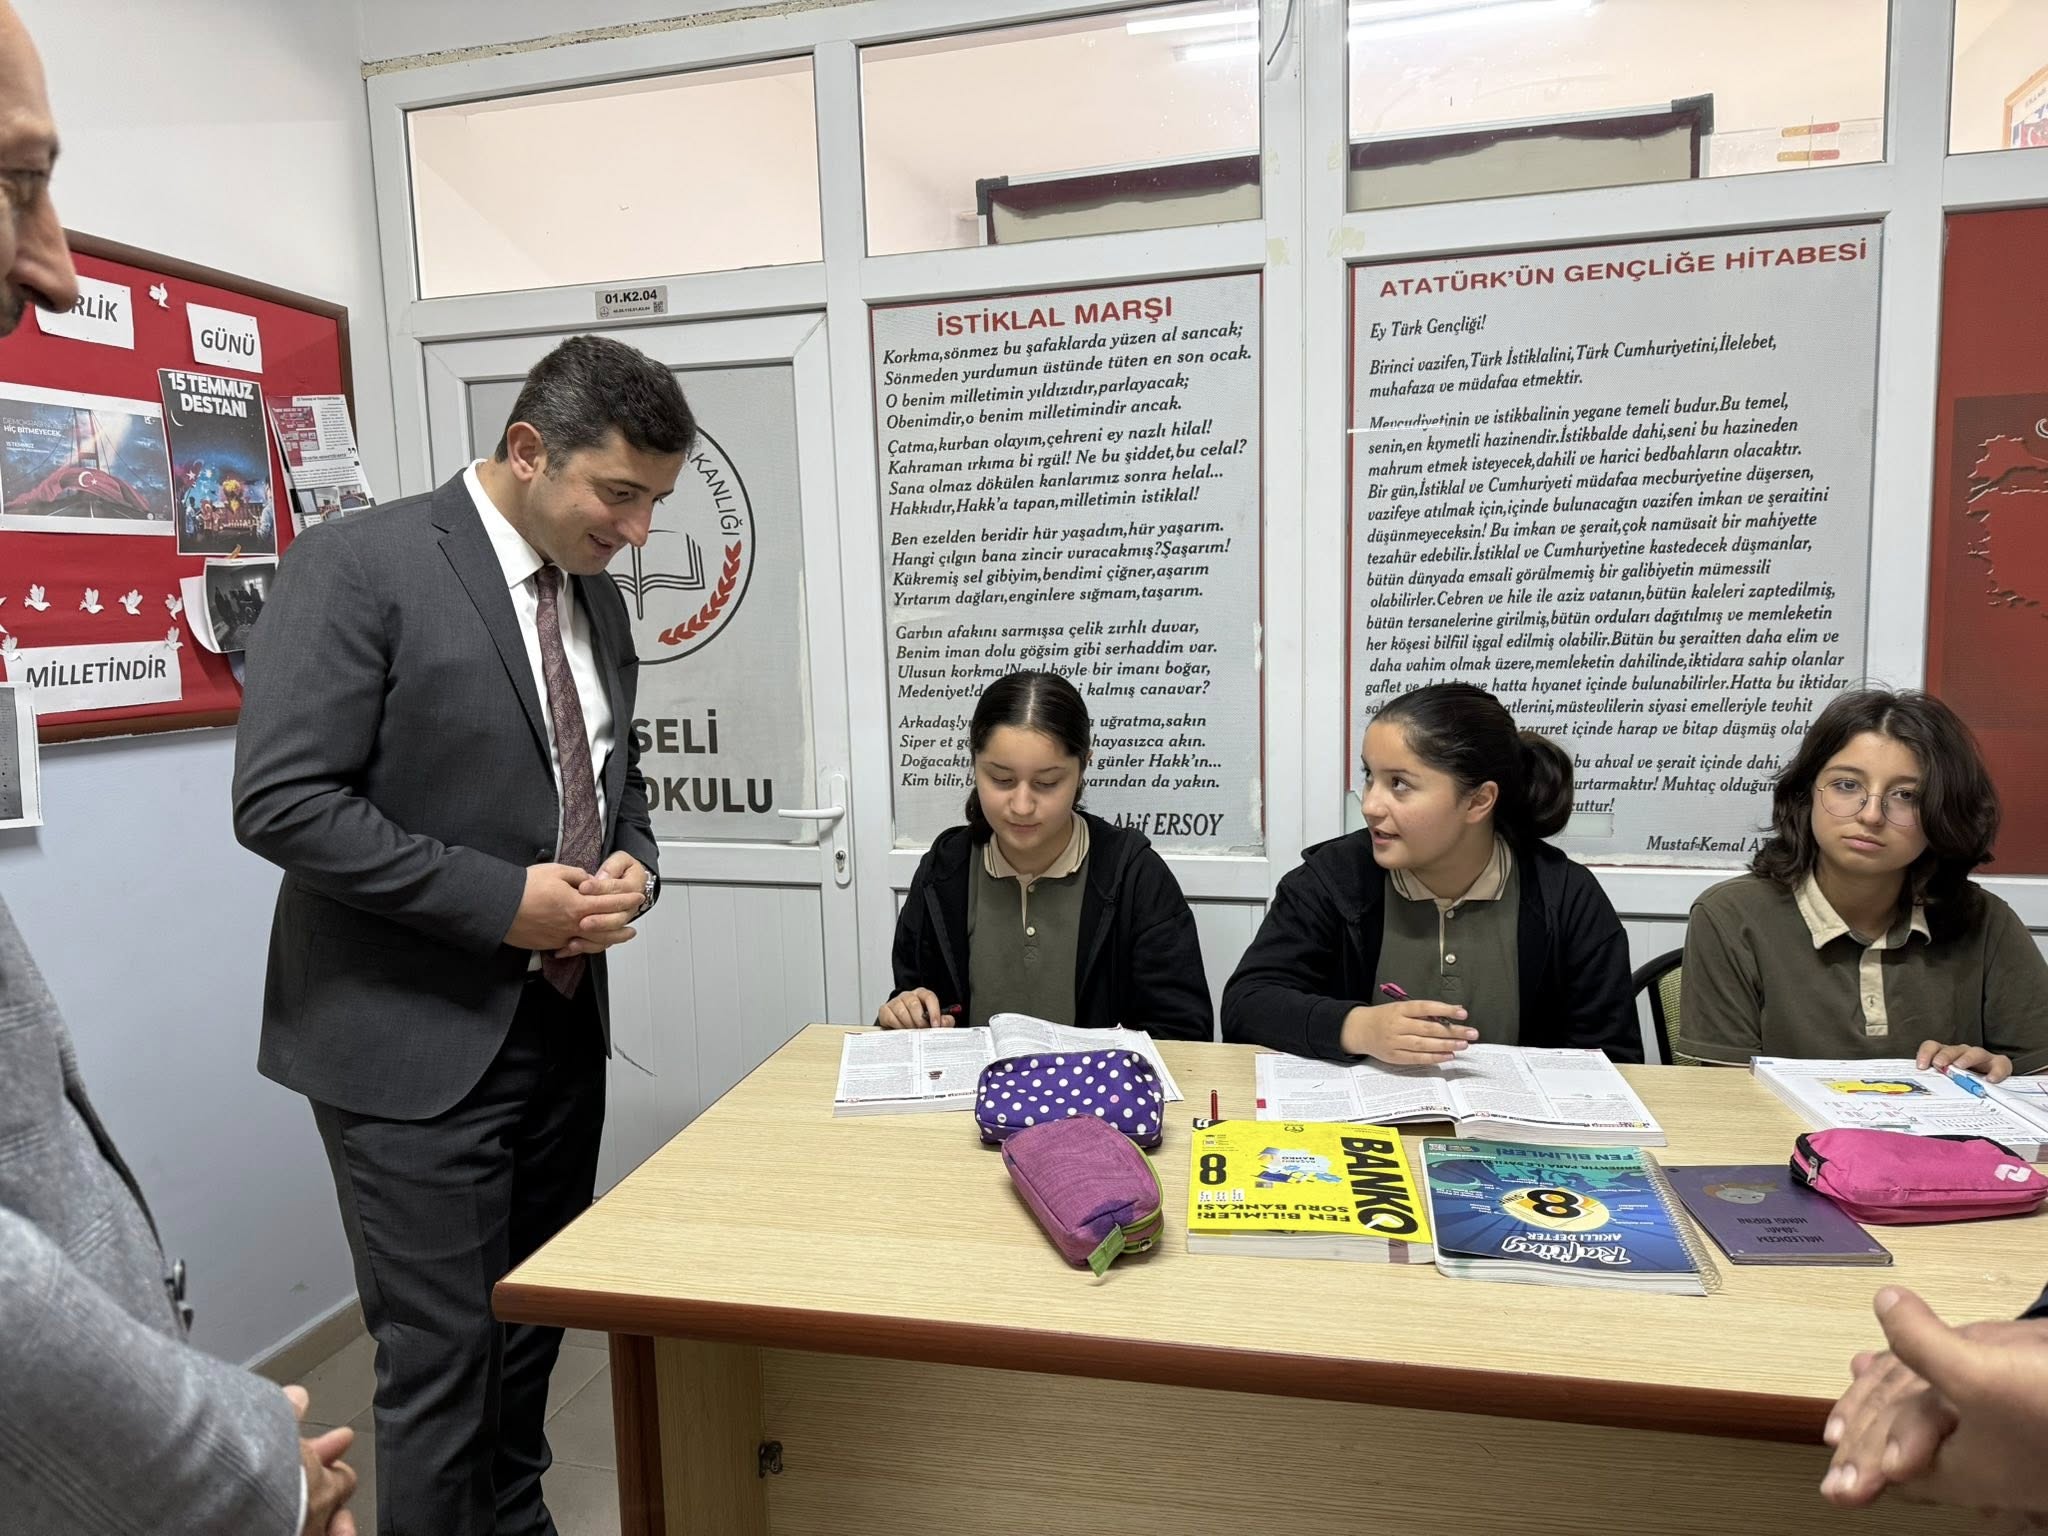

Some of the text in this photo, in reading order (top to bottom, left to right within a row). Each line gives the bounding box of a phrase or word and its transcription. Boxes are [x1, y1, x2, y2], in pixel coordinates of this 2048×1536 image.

[1379, 237, 1867, 298] ATATÜRK'ÜN GENÇLİĞE HİTABESİ
[71, 294, 118, 323] RLİK
[605, 289, 657, 304] 01.K2.04
[937, 296, 1172, 336] İSTİKLAL MARŞI
[1370, 314, 1486, 341] Ey Türk Gençliği!
[201, 327, 255, 356] GÜNÜ
[1003, 340, 1021, 355] bu
[1026, 332, 1106, 357] şafaklarda
[1109, 332, 1156, 350] yüzen
[1161, 325, 1178, 342] al
[1181, 320, 1243, 340] sancak;
[884, 344, 1251, 386] Sönmeden yurdumun üstünde tüten en son ocak.
[1369, 357, 1414, 375] Birinci
[168, 372, 254, 400] 15 TEMMUZ
[1369, 369, 1582, 398] muhafaza ve müdafaa etmektir.
[180, 392, 248, 418] DESTANI
[1106, 430, 1123, 443] ey
[1128, 422, 1166, 439] nazlı
[1171, 418, 1212, 436] hilal!
[1368, 460, 1422, 476] mahrum
[1427, 455, 1468, 473] etmek
[1579, 454, 1595, 465] ve
[1599, 447, 1640, 464] harici
[1644, 443, 1728, 462] bedbahların
[1733, 440, 1801, 458] olacaktır.
[691, 452, 743, 536] KANLIĞI
[888, 480, 924, 495] Sana
[929, 478, 972, 493] olmaz
[976, 474, 1034, 491] dökülen
[1039, 471, 1119, 488] kanlarımız
[1124, 471, 1166, 483] sonra
[1368, 504, 1420, 522] vazifeye
[1424, 500, 1475, 518] atılmak
[1552, 496, 1637, 513] bulunacağın
[1642, 491, 1693, 508] vazifen
[1698, 489, 1742, 506] imkan
[1747, 493, 1764, 504] ve
[1767, 486, 1830, 507] şeraitini
[890, 531, 918, 546] Ben
[922, 529, 976, 544] ezelden
[980, 526, 1028, 542] beridir
[1032, 525, 1058, 540] hür
[1157, 522, 1224, 537] yaşarım.
[1366, 558, 1771, 587] bütün dünyada emsali görülmemiş bir galibiyetin mümessili
[895, 618, 1198, 639] Garbın afakını sarmışsa çelik zırhlı duvar,
[1366, 636, 1387, 651] her
[1390, 635, 1430, 654] köşesi
[1433, 634, 1469, 649] bilfiil
[1472, 633, 1504, 652] işgal
[1506, 632, 1554, 650] edilmiş
[1658, 629, 1676, 645] bu
[1679, 629, 1741, 648] şeraitten
[1746, 627, 1782, 644] daha
[1786, 627, 1818, 643] elim
[1822, 632, 1839, 643] ve
[896, 639, 1217, 660] Benim iman dolu göğsim gibi serhaddim var.
[26, 654, 166, 688] MİLLETİNDİR
[1092, 660, 1210, 677] bir imanı boğar,
[1086, 679, 1210, 698] kalmış canavar?
[1648, 696, 1813, 716] siyasi emelleriyle tevhit
[631, 708, 718, 754] SELİ
[1091, 733, 1205, 750] hayasızca akın.
[1572, 719, 1776, 738] içinde harap ve bitap düşmüş
[1097, 753, 1145, 770] günler
[1151, 773, 1219, 790] da yakın.
[1661, 775, 1716, 794] Muhtaç
[1153, 813, 1224, 836] ERSOY
[1496, 1148, 1591, 1161] BİLİMLERİ
[1200, 1153, 1227, 1185] 8
[1341, 1136, 1418, 1235] BANKO
[1294, 1204, 1349, 1212] SORU
[1527, 1189, 1582, 1219] 8
[1309, 1213, 1351, 1222] FEN
[1526, 1231, 1622, 1241] AKILLI DEFTER
[1501, 1236, 1632, 1265] Rafting
